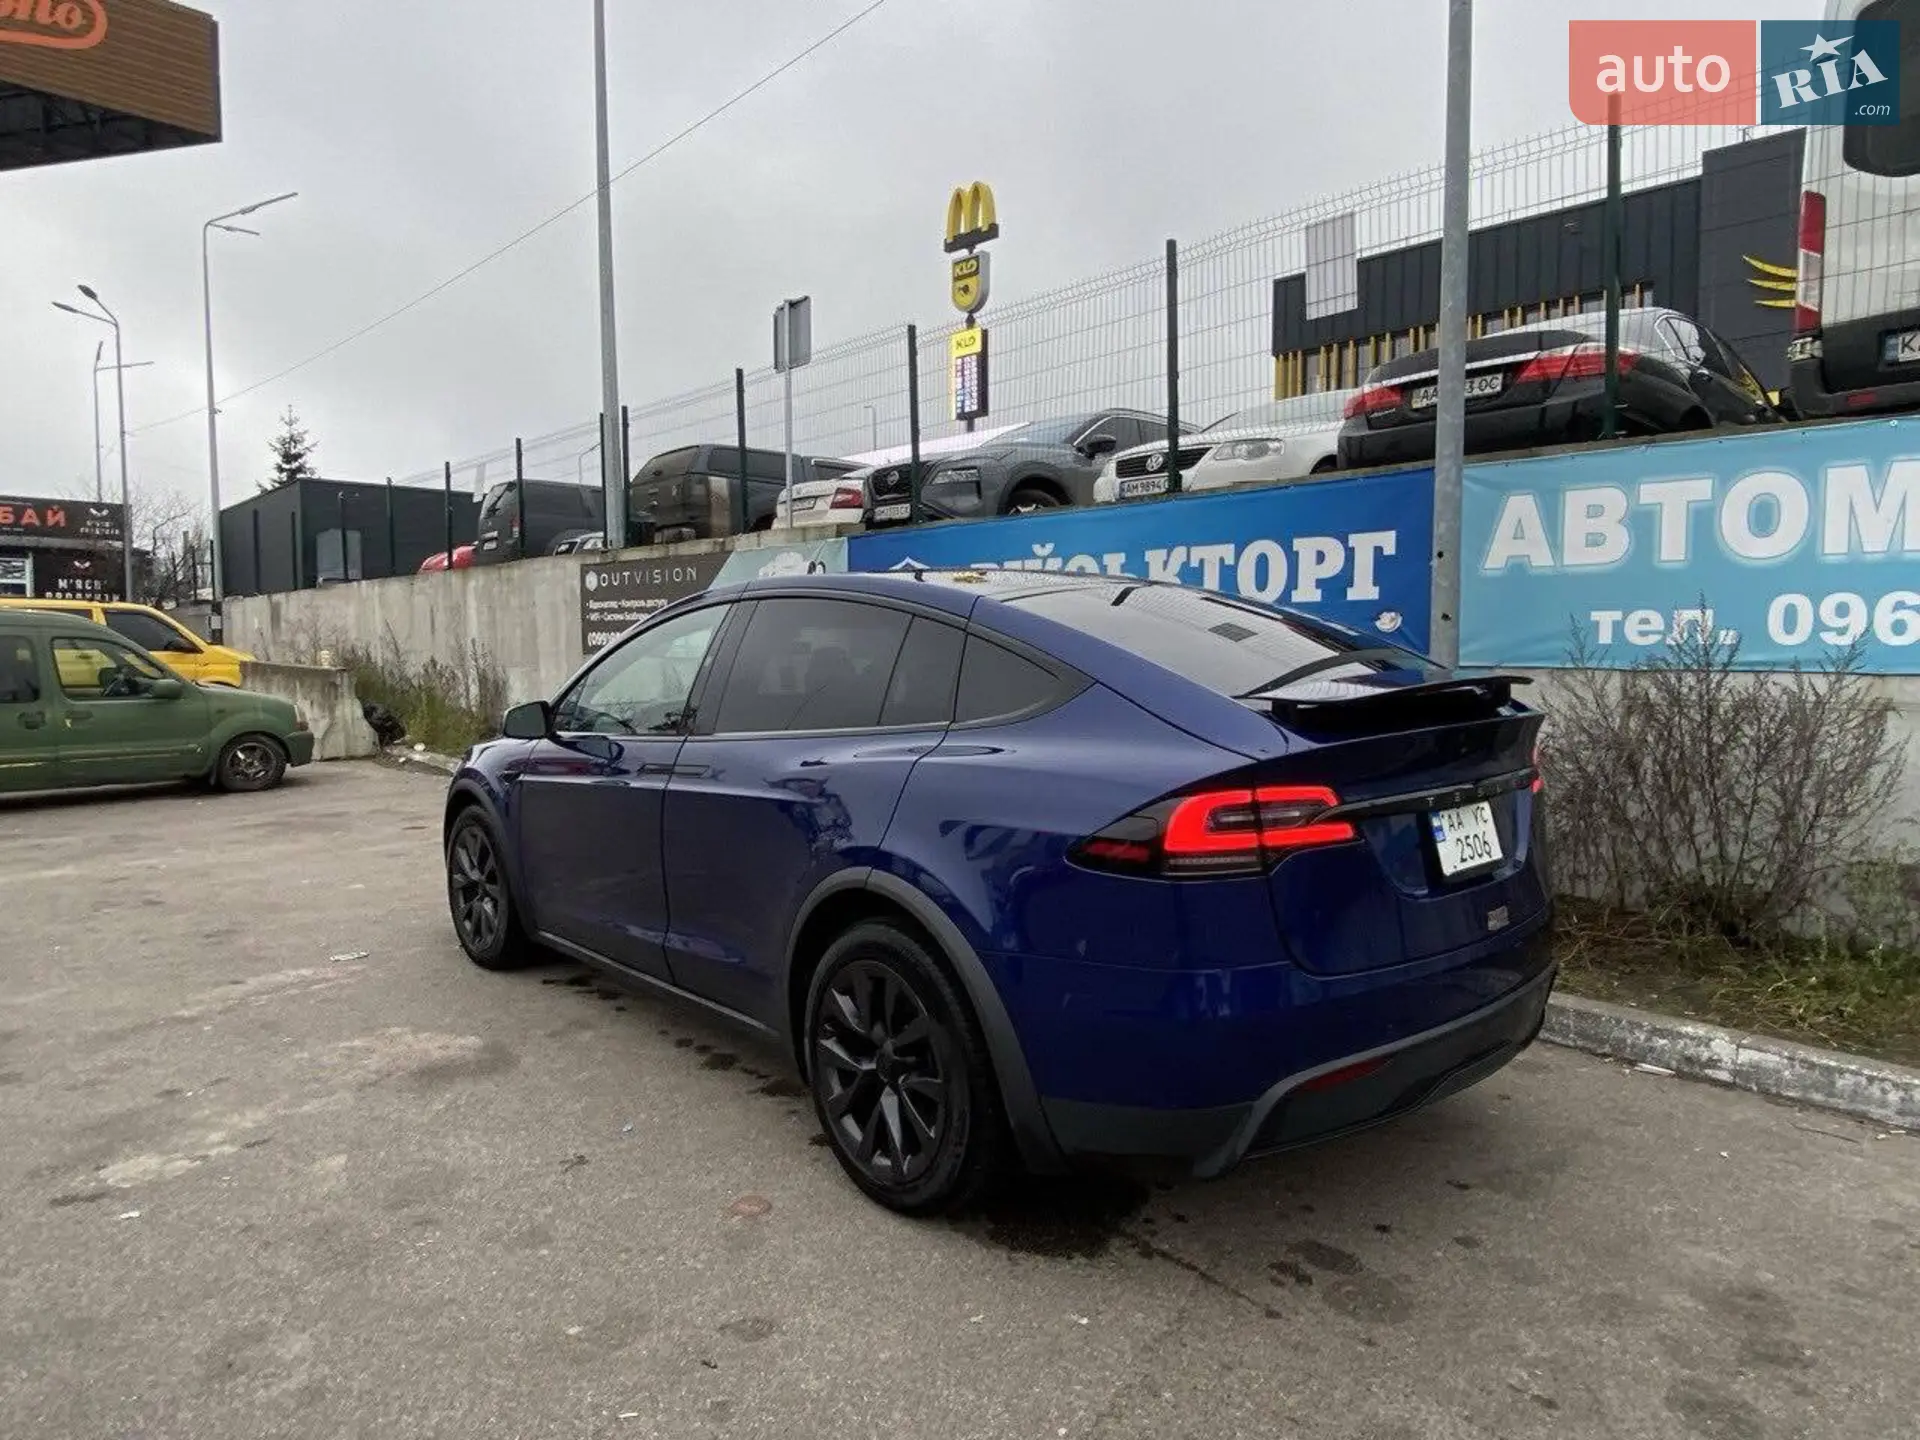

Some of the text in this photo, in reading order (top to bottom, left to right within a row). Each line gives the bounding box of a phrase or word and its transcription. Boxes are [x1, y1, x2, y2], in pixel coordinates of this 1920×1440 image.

[1901, 334, 1920, 354] K
[1483, 457, 1920, 570] АВТОМ
[600, 567, 697, 587] OUTVISION
[970, 530, 1397, 604] КТОРГ
[1590, 590, 1920, 647] тел. 096
[1448, 812, 1464, 832] AA
[1456, 831, 1492, 863] 2506
